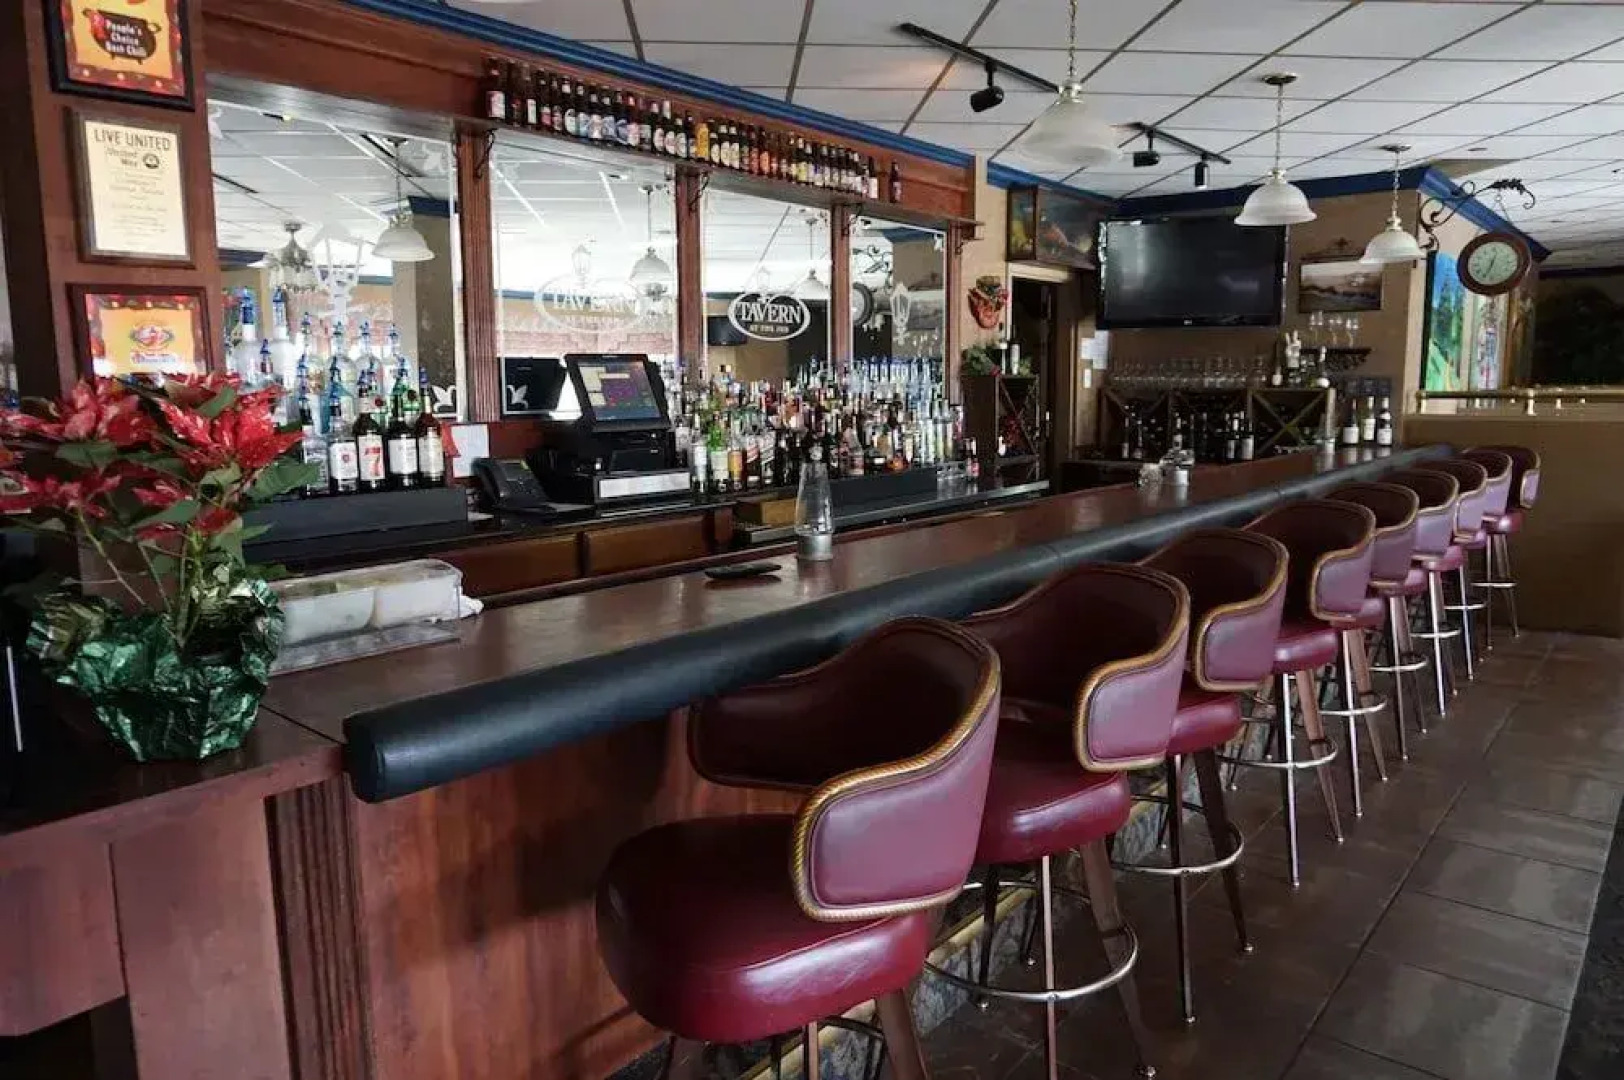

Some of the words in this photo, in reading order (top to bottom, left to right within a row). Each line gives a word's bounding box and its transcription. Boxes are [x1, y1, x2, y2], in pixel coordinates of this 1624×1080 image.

[94, 129, 121, 145] LIVE
[125, 132, 171, 151] UNITED
[736, 301, 802, 324] TAVERN
